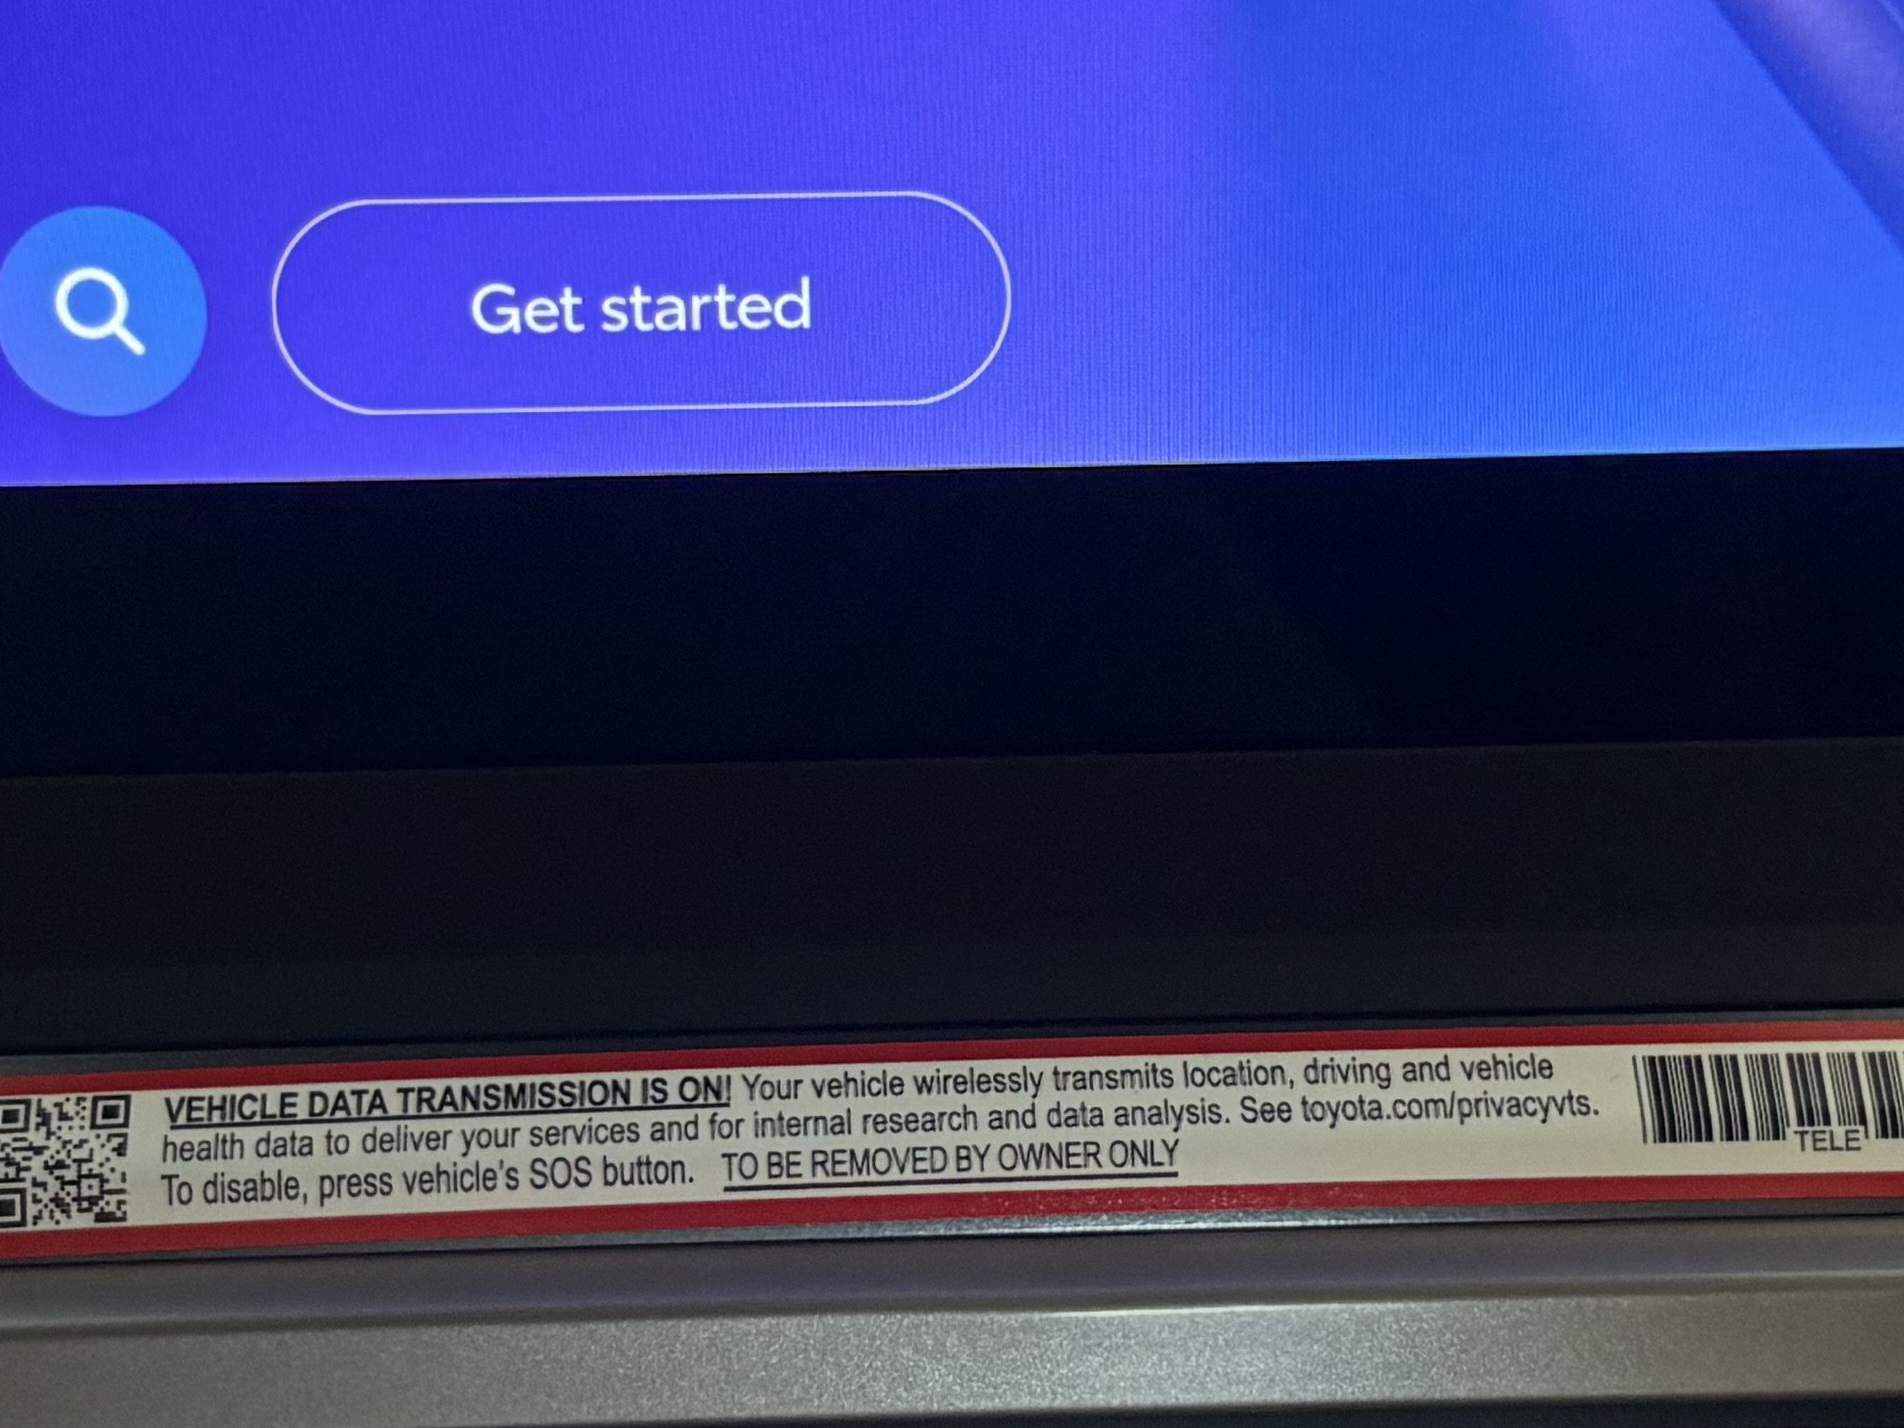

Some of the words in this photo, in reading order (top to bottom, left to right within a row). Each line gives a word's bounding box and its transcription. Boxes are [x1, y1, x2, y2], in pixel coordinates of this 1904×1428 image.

[472, 283, 584, 333] Get
[602, 276, 810, 331] started
[164, 1093, 300, 1124] VEHICLE
[307, 1089, 388, 1118] DATA
[396, 1078, 631, 1114] TRANSMISSION
[642, 1078, 668, 1104] IS
[679, 1075, 731, 1103] ON!
[742, 1074, 803, 1101] Your
[811, 1070, 904, 1098] vehicle
[913, 1066, 1043, 1099] wirelessly
[1052, 1062, 1174, 1091] transmits
[1183, 1059, 1294, 1089] location,
[1304, 1057, 1391, 1089] driving
[1402, 1054, 1450, 1082] and
[1460, 1053, 1553, 1080] vehicle
[163, 1132, 244, 1163] health
[255, 1131, 313, 1158] data
[325, 1130, 349, 1156] to
[362, 1125, 452, 1154] deliver
[461, 1127, 520, 1157] your
[530, 1122, 640, 1147] services
[650, 1114, 698, 1142] and
[709, 1112, 745, 1140] for
[754, 1108, 851, 1138] internal
[863, 1104, 977, 1134] research
[988, 1102, 1036, 1130] and
[1047, 1101, 1104, 1128] data
[1114, 1098, 1230, 1132] analysis.
[1240, 1096, 1292, 1123] See
[1301, 1090, 1599, 1129] toyota.com/privacyvts.
[1794, 1129, 1861, 1152] TELE
[161, 1174, 192, 1206] To
[203, 1169, 307, 1204] disable,
[320, 1173, 393, 1207] press
[402, 1160, 519, 1195] vehicle's
[530, 1156, 592, 1189] SOS
[603, 1155, 693, 1186] button.
[721, 1152, 758, 1181] TO
[768, 1151, 802, 1179] BE
[812, 1146, 947, 1177] REMOVED
[956, 1144, 990, 1172] BY
[998, 1141, 1102, 1171] OWNER
[1109, 1139, 1179, 1168] ONLY
